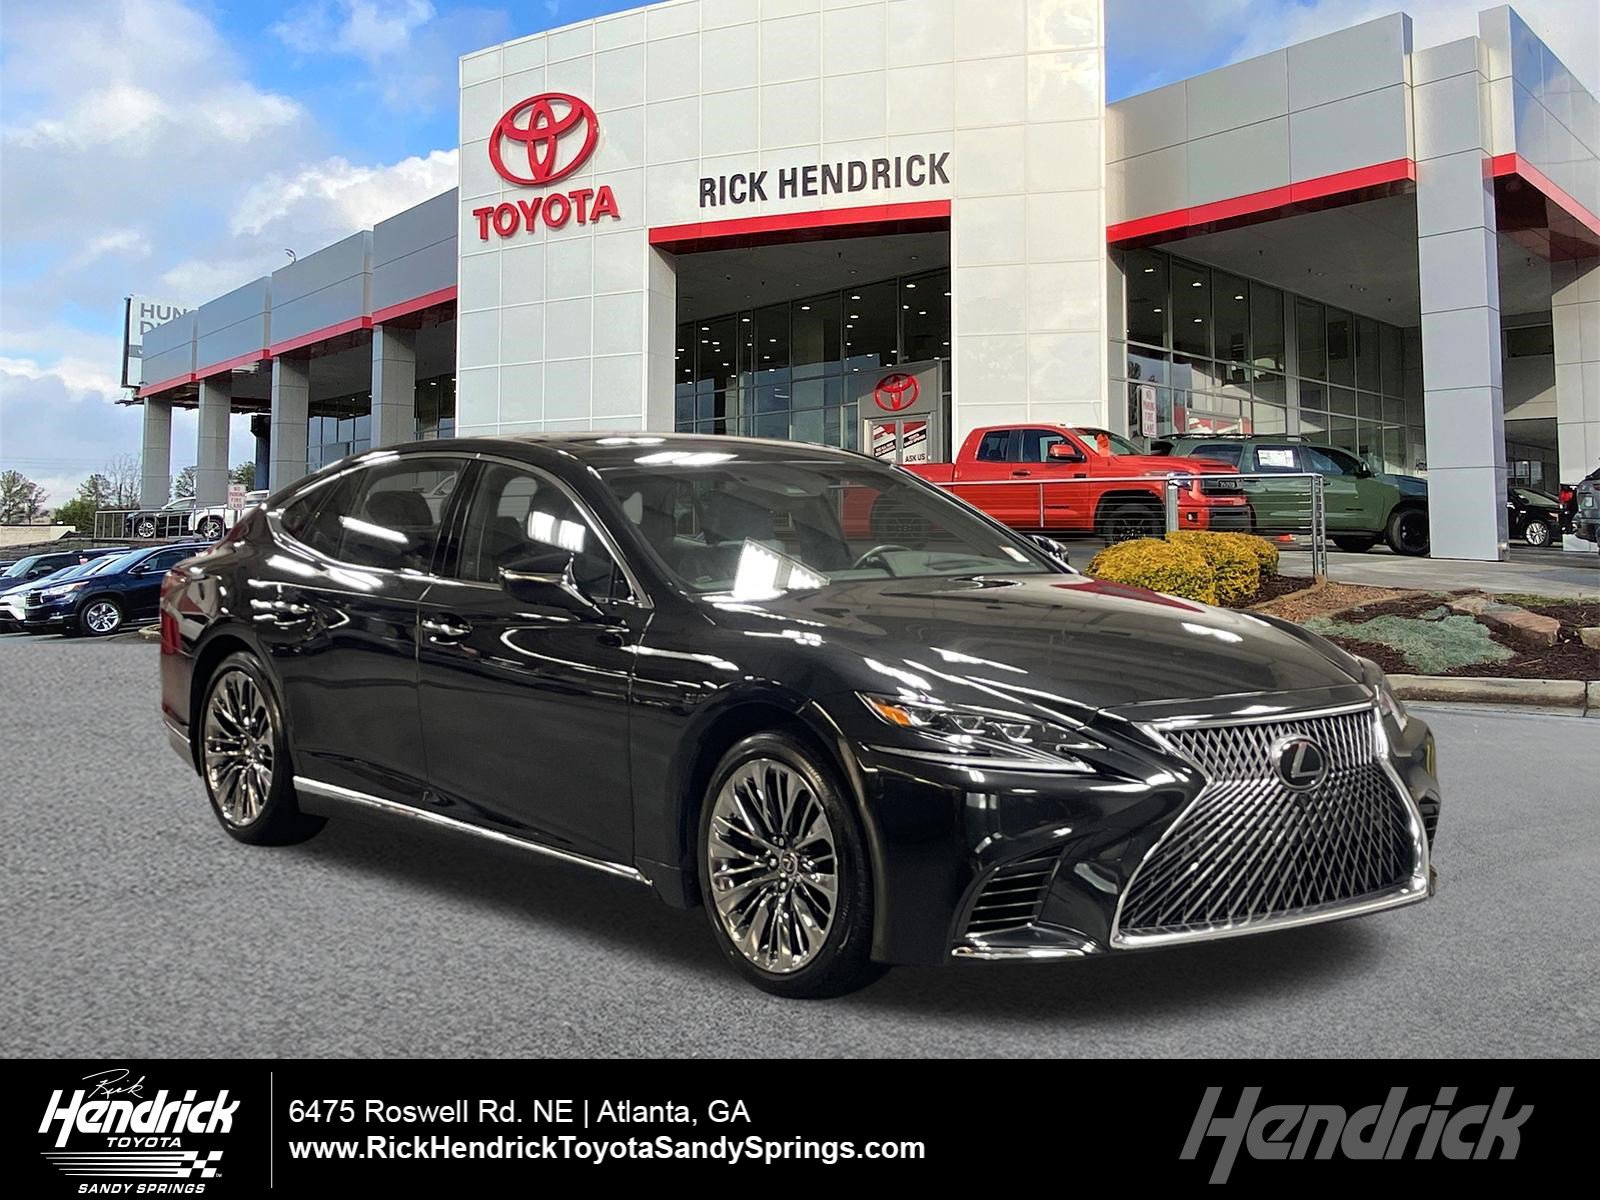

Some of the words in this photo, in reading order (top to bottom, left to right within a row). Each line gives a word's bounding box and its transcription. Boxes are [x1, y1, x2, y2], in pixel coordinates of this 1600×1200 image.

[699, 170, 768, 208] RICK
[778, 152, 950, 199] HENDRICK
[472, 185, 621, 241] TOYOTA
[904, 455, 917, 463] ASK
[917, 453, 926, 461] US
